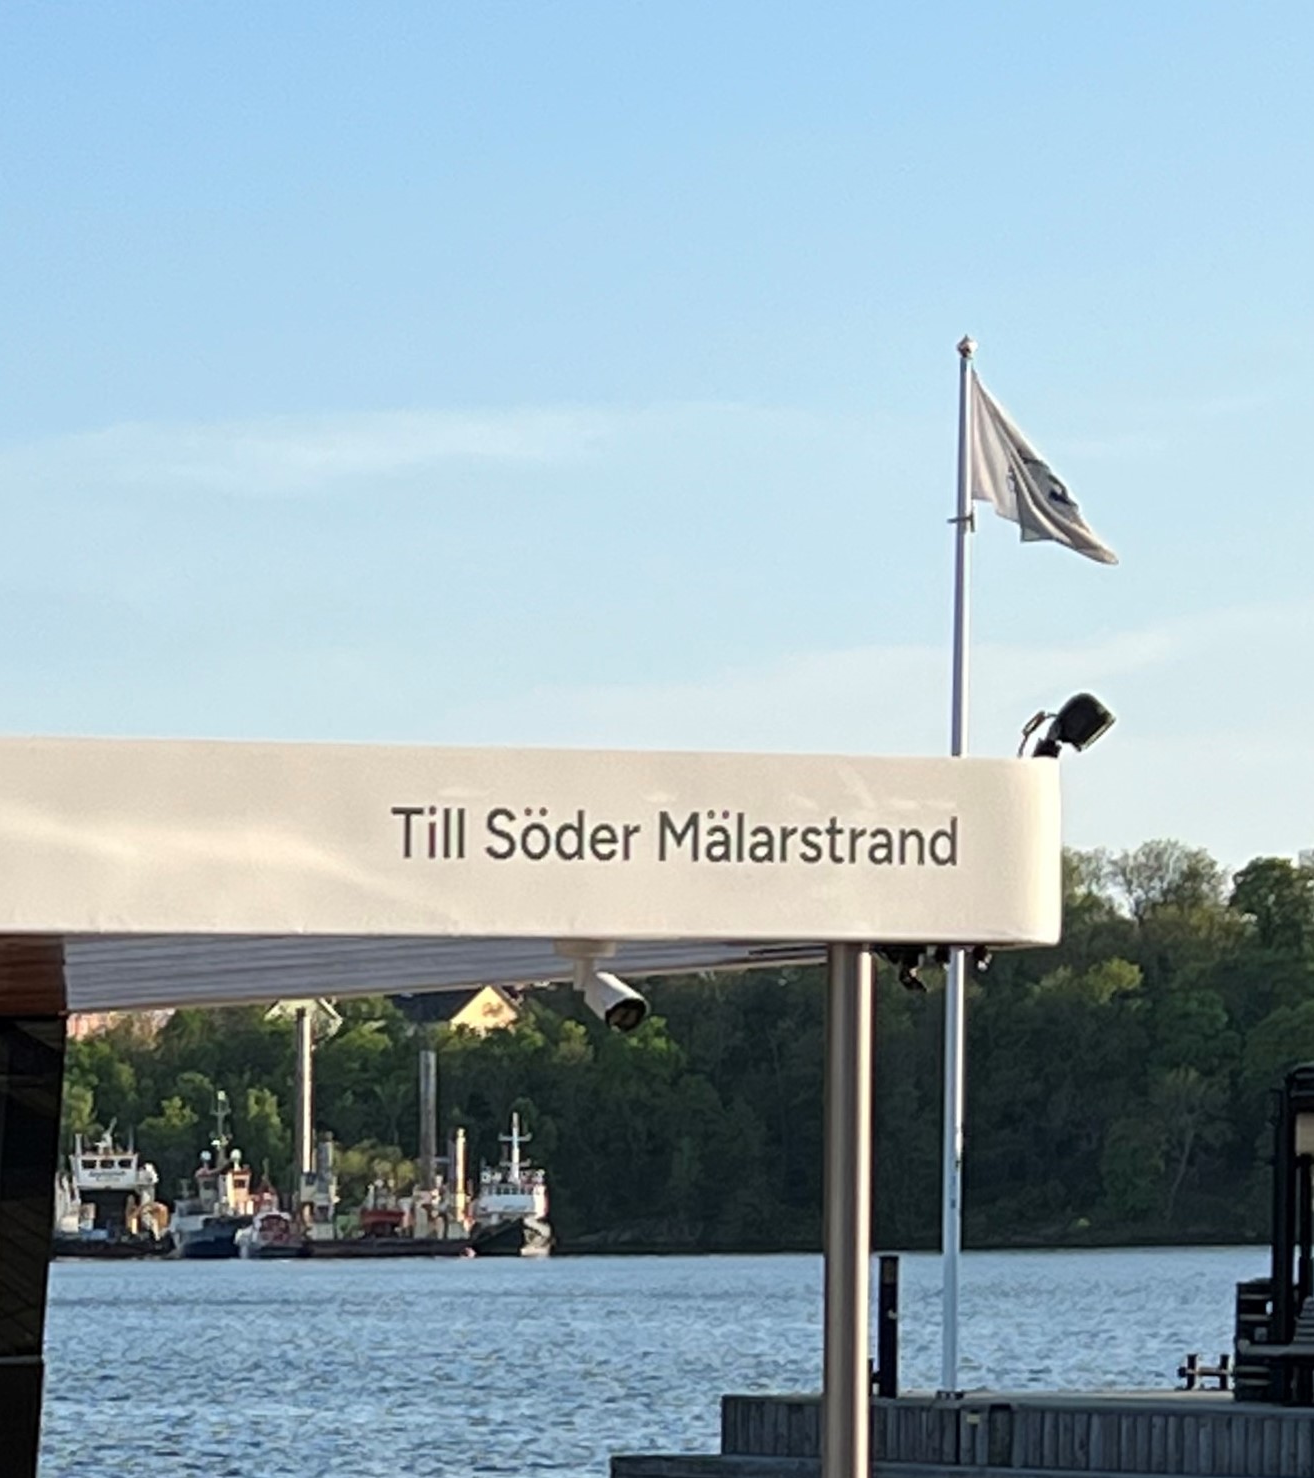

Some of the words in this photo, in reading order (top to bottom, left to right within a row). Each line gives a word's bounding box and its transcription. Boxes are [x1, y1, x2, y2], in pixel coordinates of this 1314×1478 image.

[391, 806, 466, 859] Till
[485, 807, 640, 861] Söder
[658, 810, 958, 867] Mälarstrand
